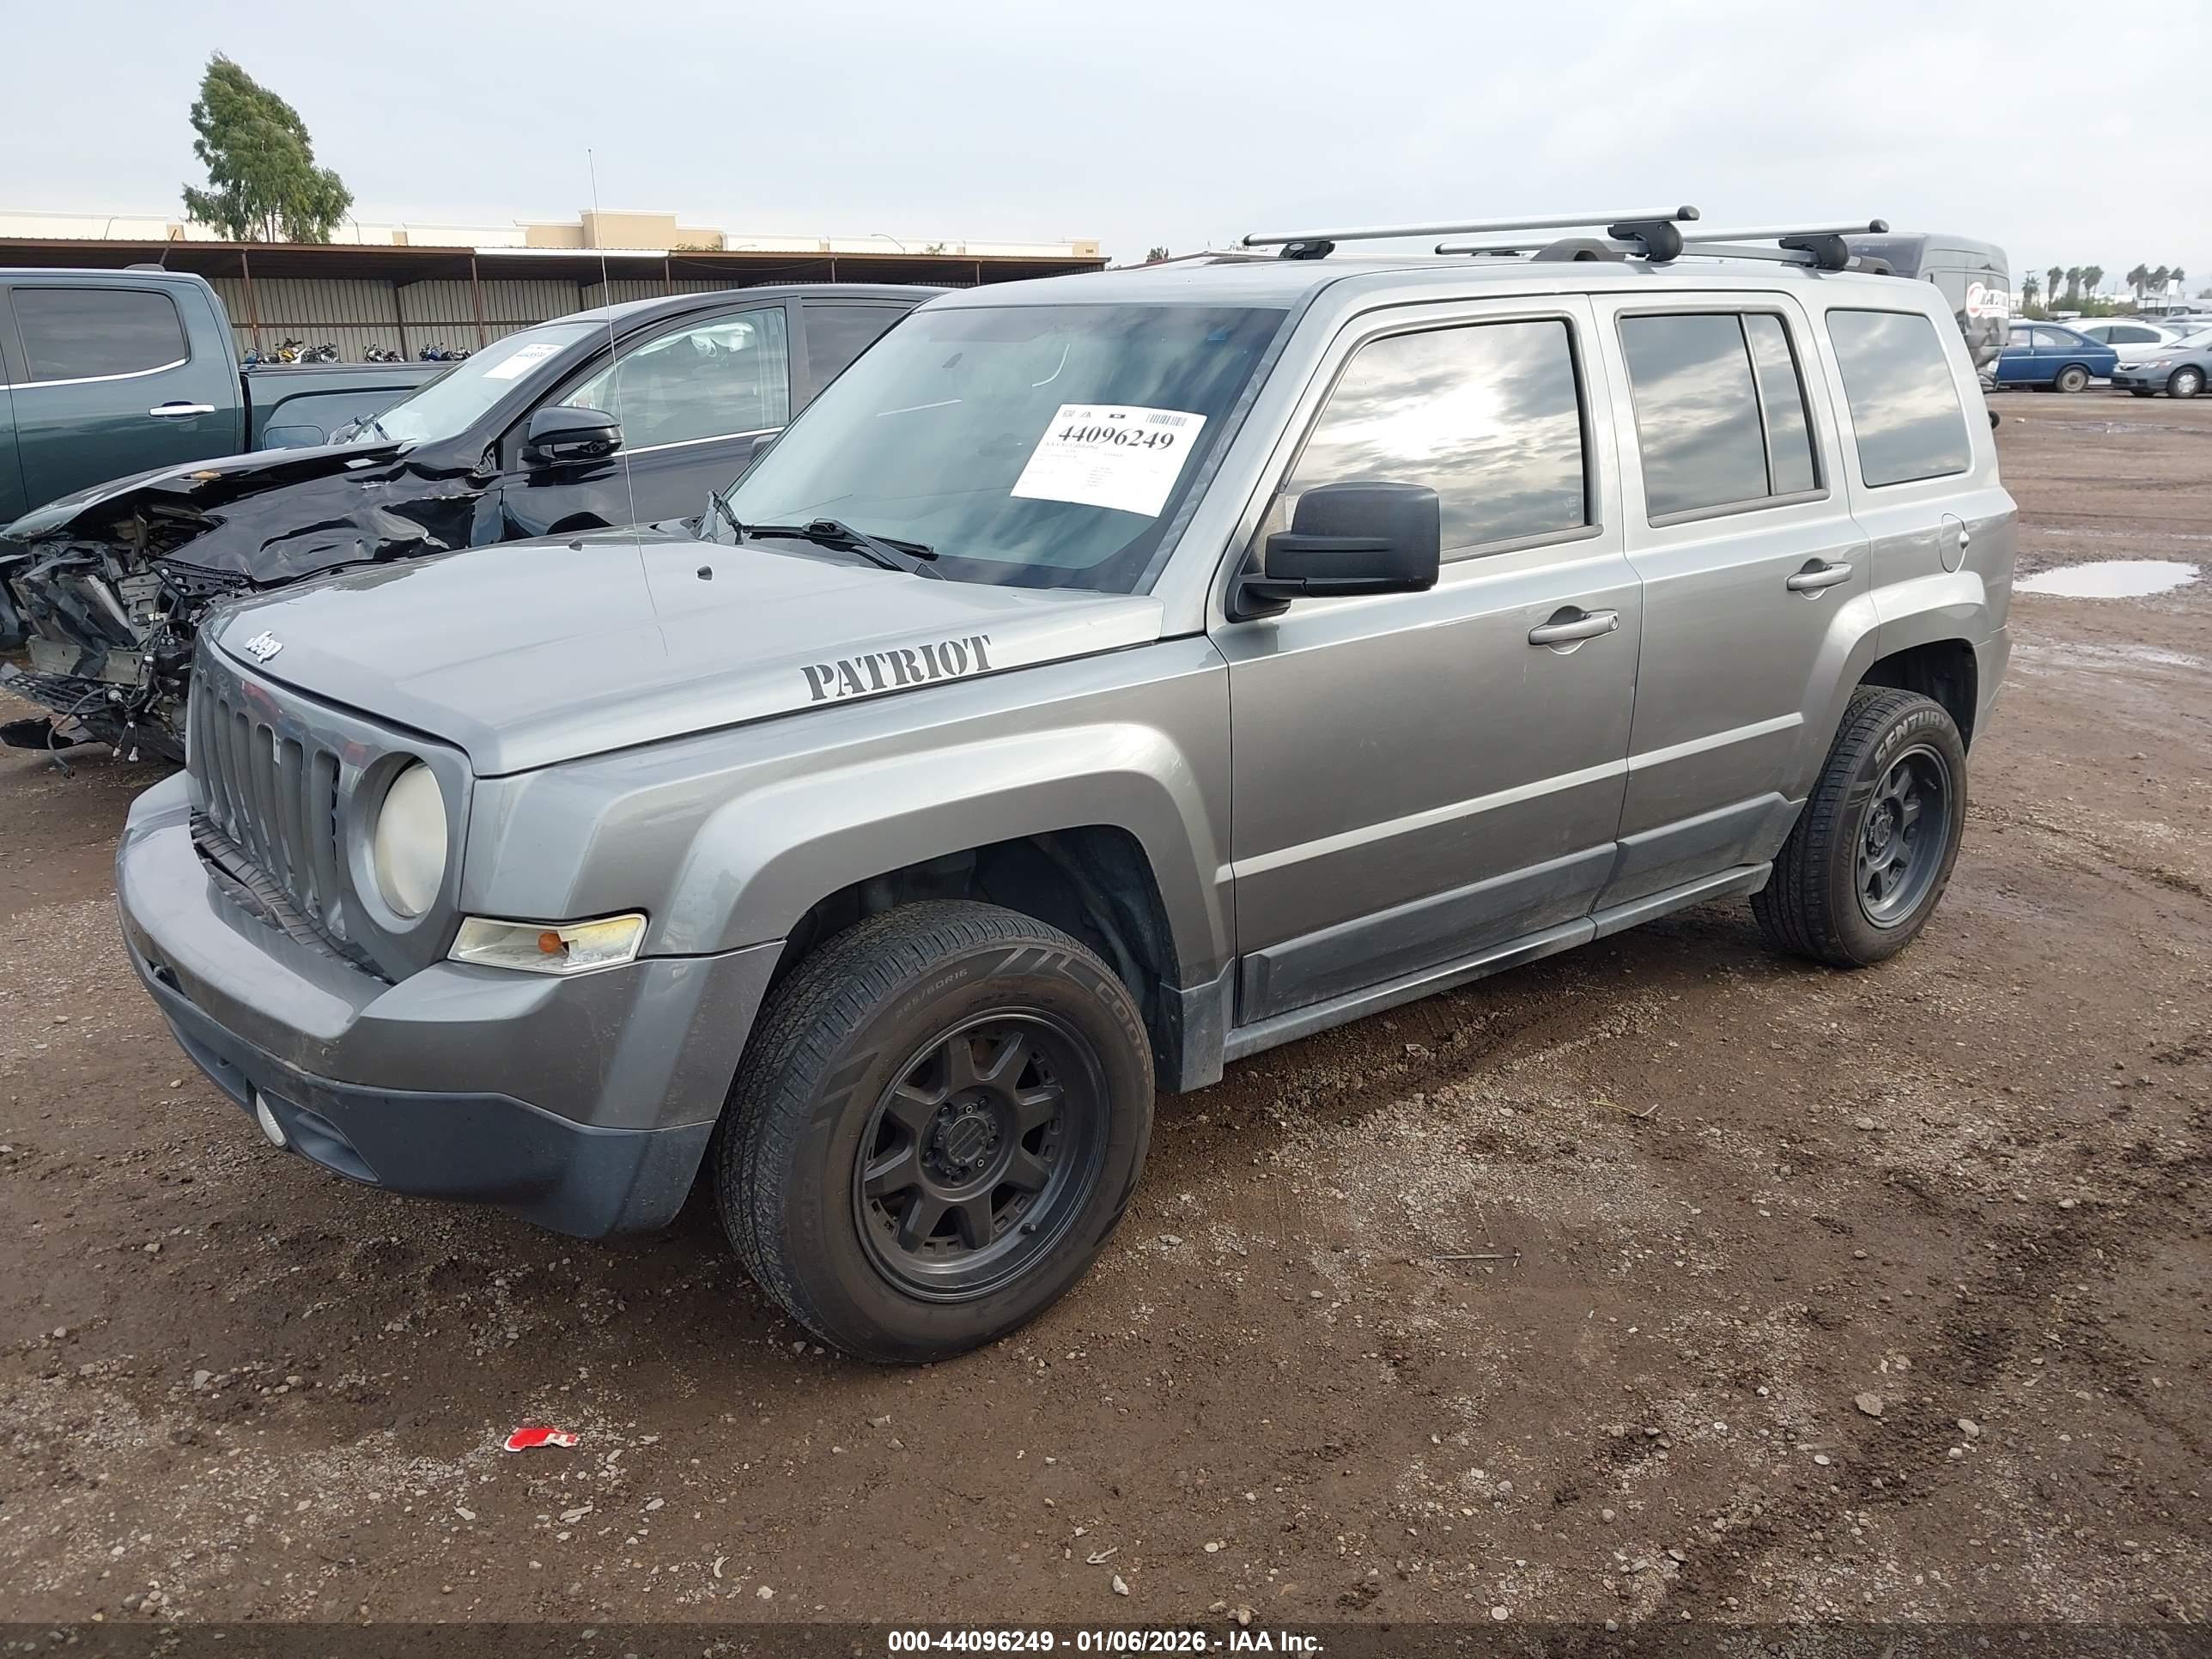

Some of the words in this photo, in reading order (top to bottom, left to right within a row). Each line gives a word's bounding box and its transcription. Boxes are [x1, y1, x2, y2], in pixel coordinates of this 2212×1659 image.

[1058, 425, 1175, 451] 44096249
[244, 630, 283, 664] Jeep
[799, 634, 992, 702] PATRIOT
[1874, 710, 1950, 771] SENTURY
